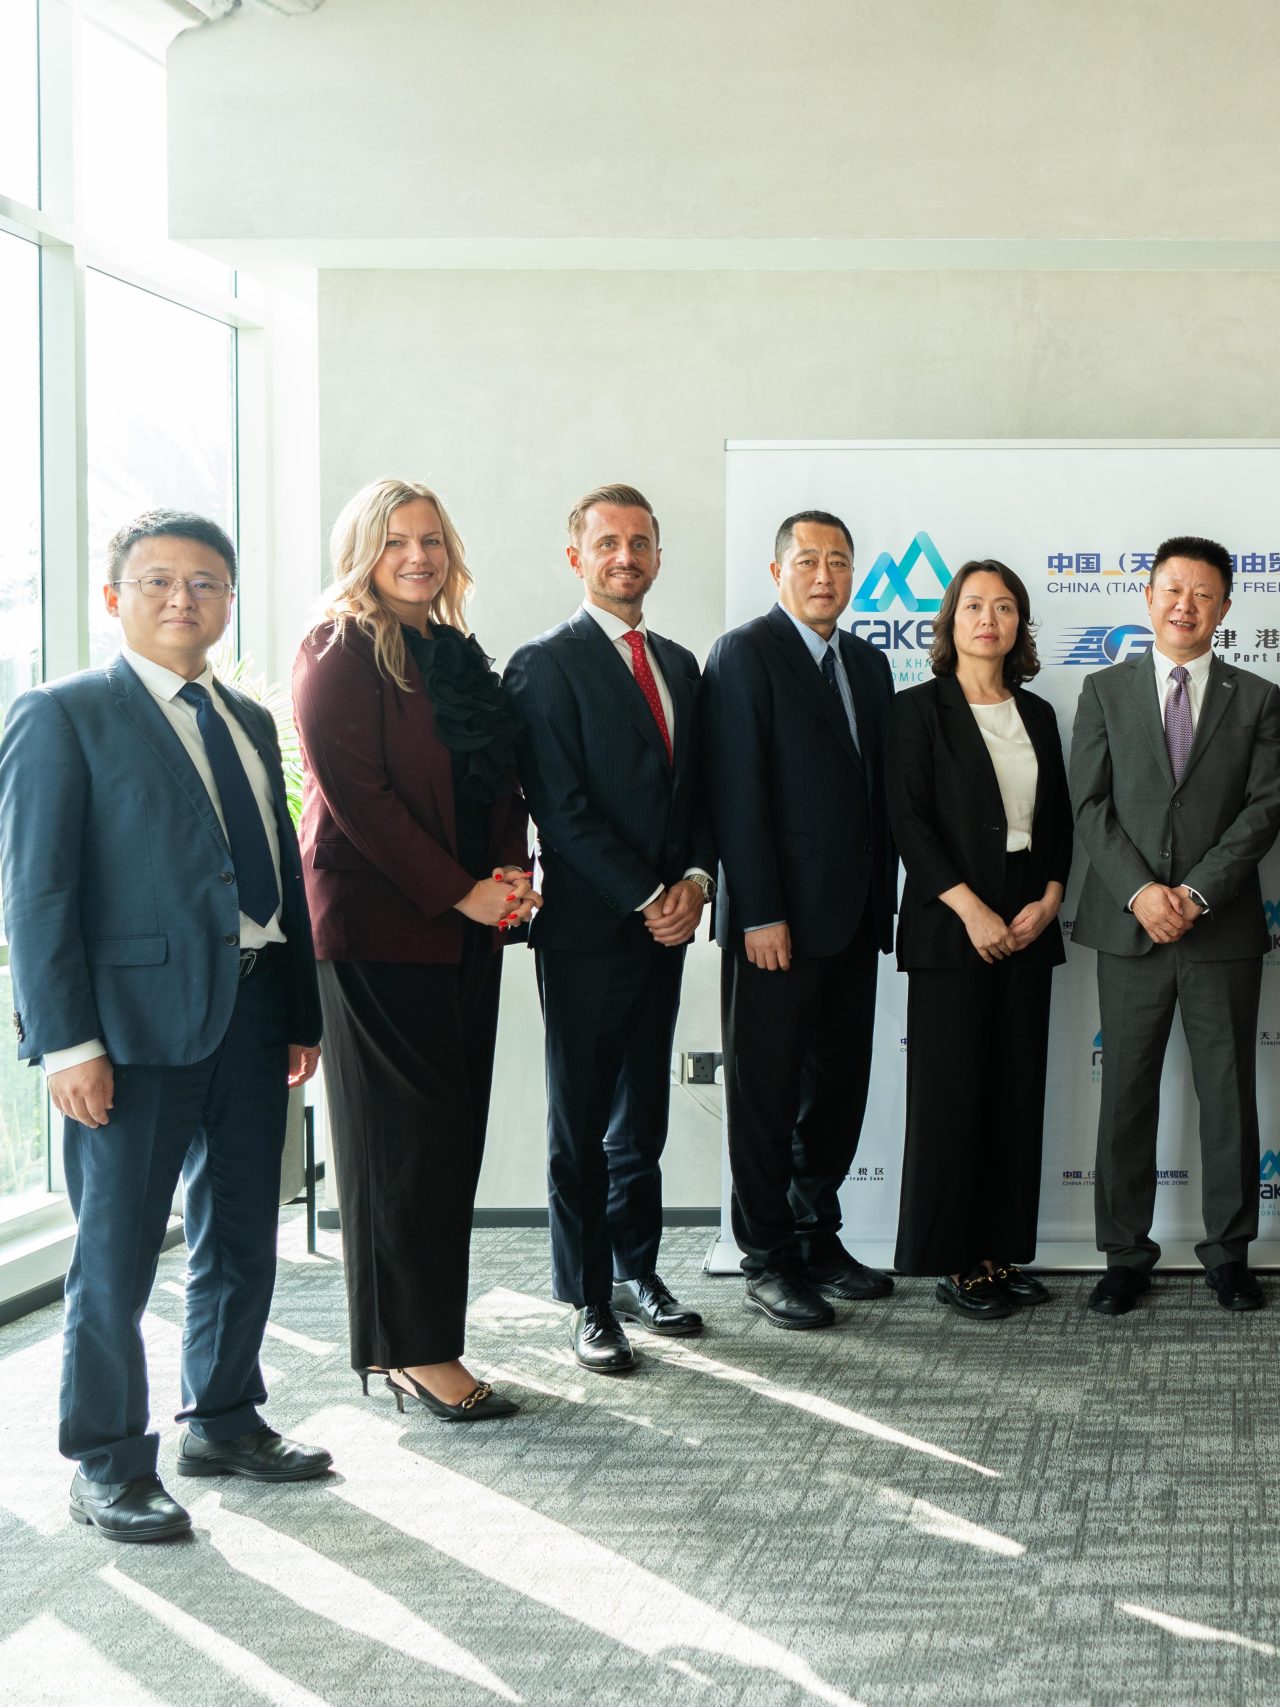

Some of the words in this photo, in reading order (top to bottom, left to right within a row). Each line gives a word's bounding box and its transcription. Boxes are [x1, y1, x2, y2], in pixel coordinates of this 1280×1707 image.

[1047, 582, 1101, 593] CHINA
[851, 620, 936, 649] rake
[1233, 652, 1268, 663] Port
